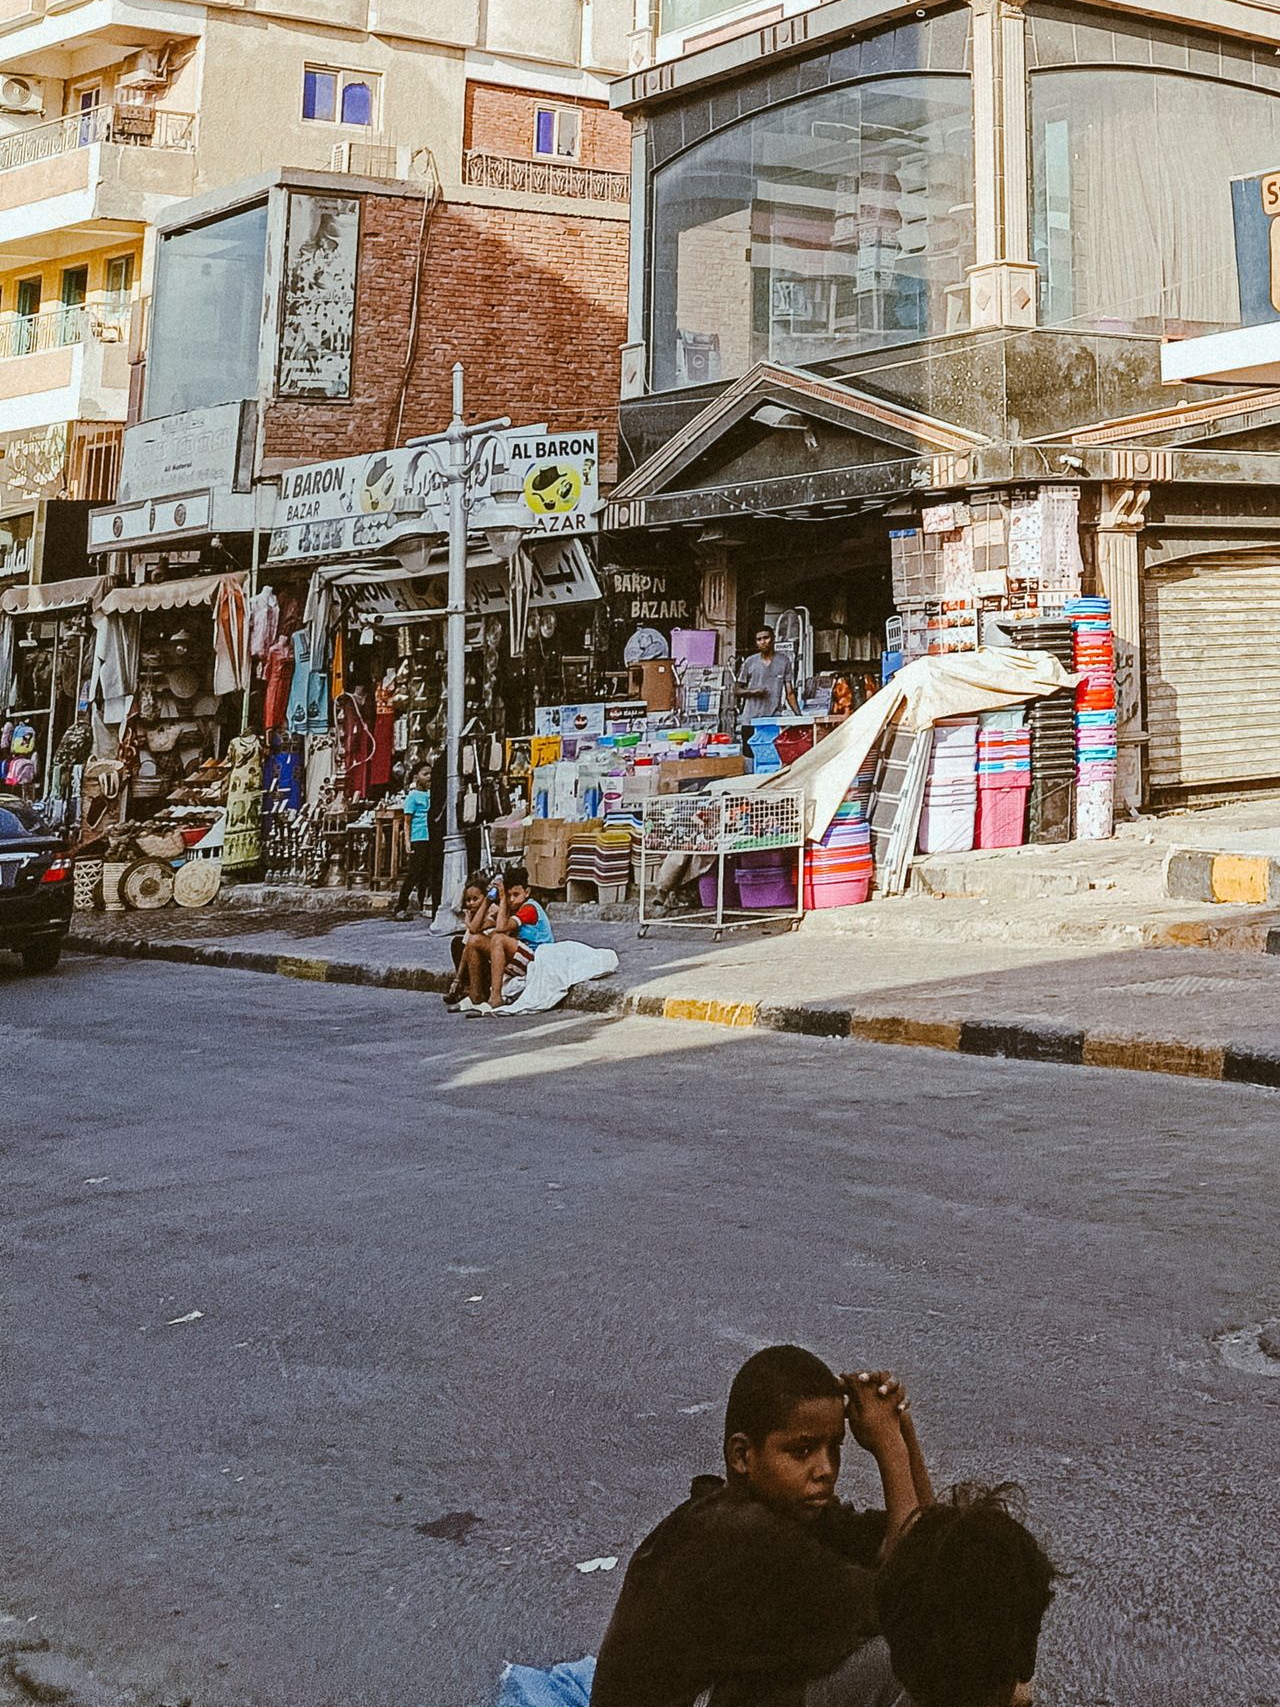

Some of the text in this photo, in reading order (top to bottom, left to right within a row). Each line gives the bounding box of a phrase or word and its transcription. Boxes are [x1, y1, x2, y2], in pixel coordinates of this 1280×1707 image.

[511, 438, 595, 460] AL BARON
[292, 466, 345, 499] BARON
[286, 500, 321, 522] BAZAR
[526, 513, 587, 535] AZAR
[613, 572, 666, 594] BARON
[631, 599, 690, 619] BAZAAR
